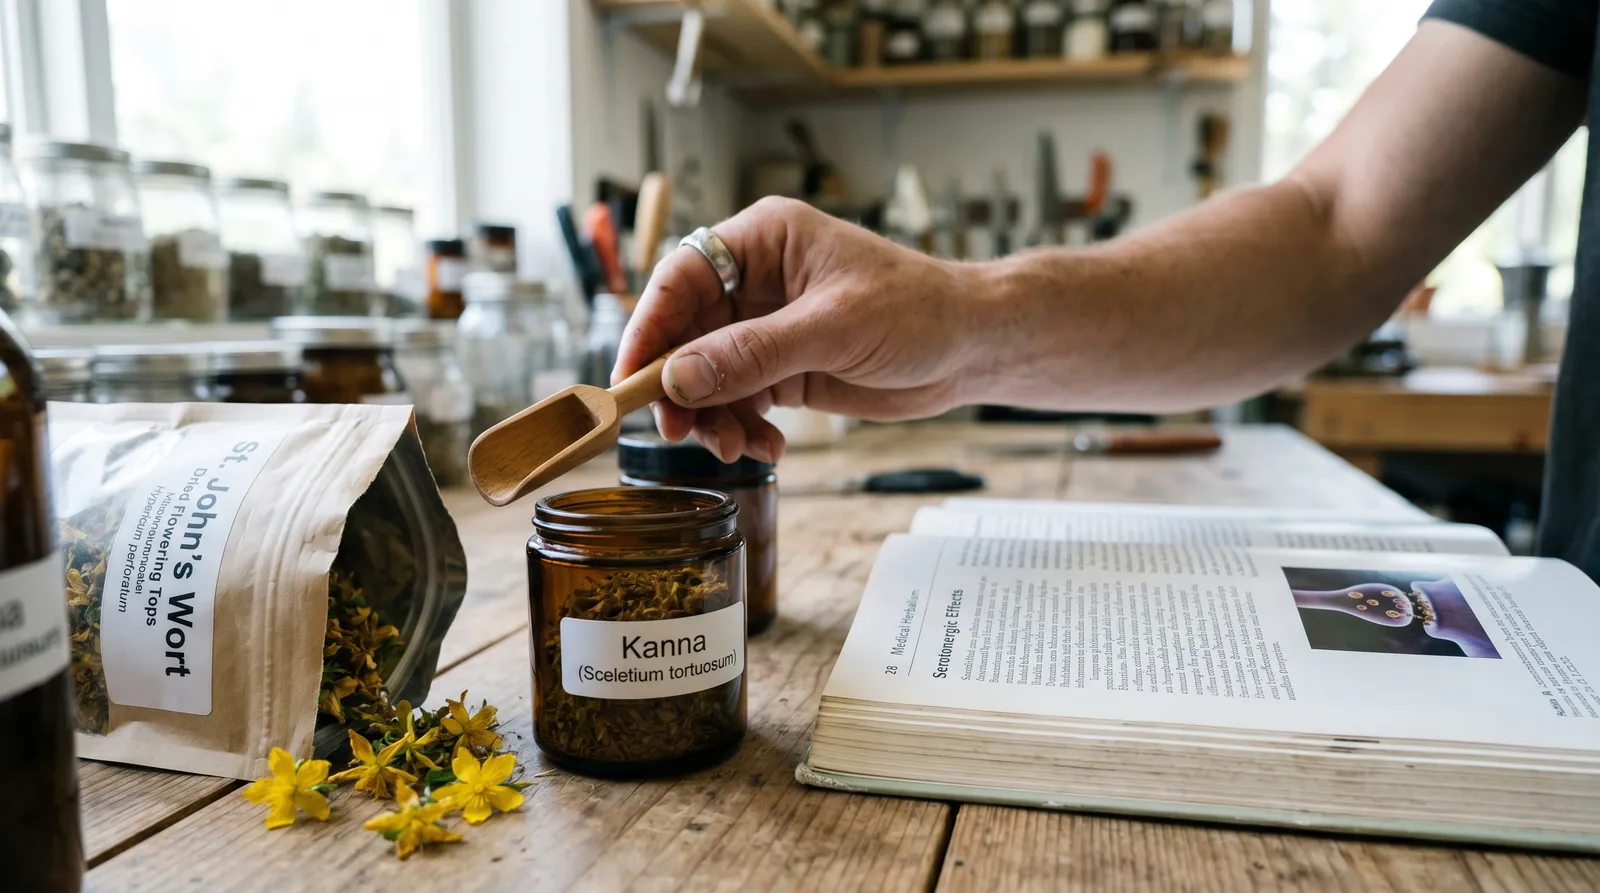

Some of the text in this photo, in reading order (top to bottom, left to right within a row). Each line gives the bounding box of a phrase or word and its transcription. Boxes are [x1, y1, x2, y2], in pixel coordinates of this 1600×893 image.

[133, 485, 165, 541] Hypericum
[178, 468, 208, 501] Dried
[149, 505, 186, 582] Flowering
[165, 441, 259, 677] St. John's Wort
[118, 543, 138, 612] perforatum
[144, 587, 162, 627] Tops
[622, 633, 706, 660] Kanna
[885, 589, 920, 675] 28 Medical Herbalism
[932, 589, 963, 679] Serotonergic Effects
[578, 649, 737, 683] (Sceletium tortuosum)
